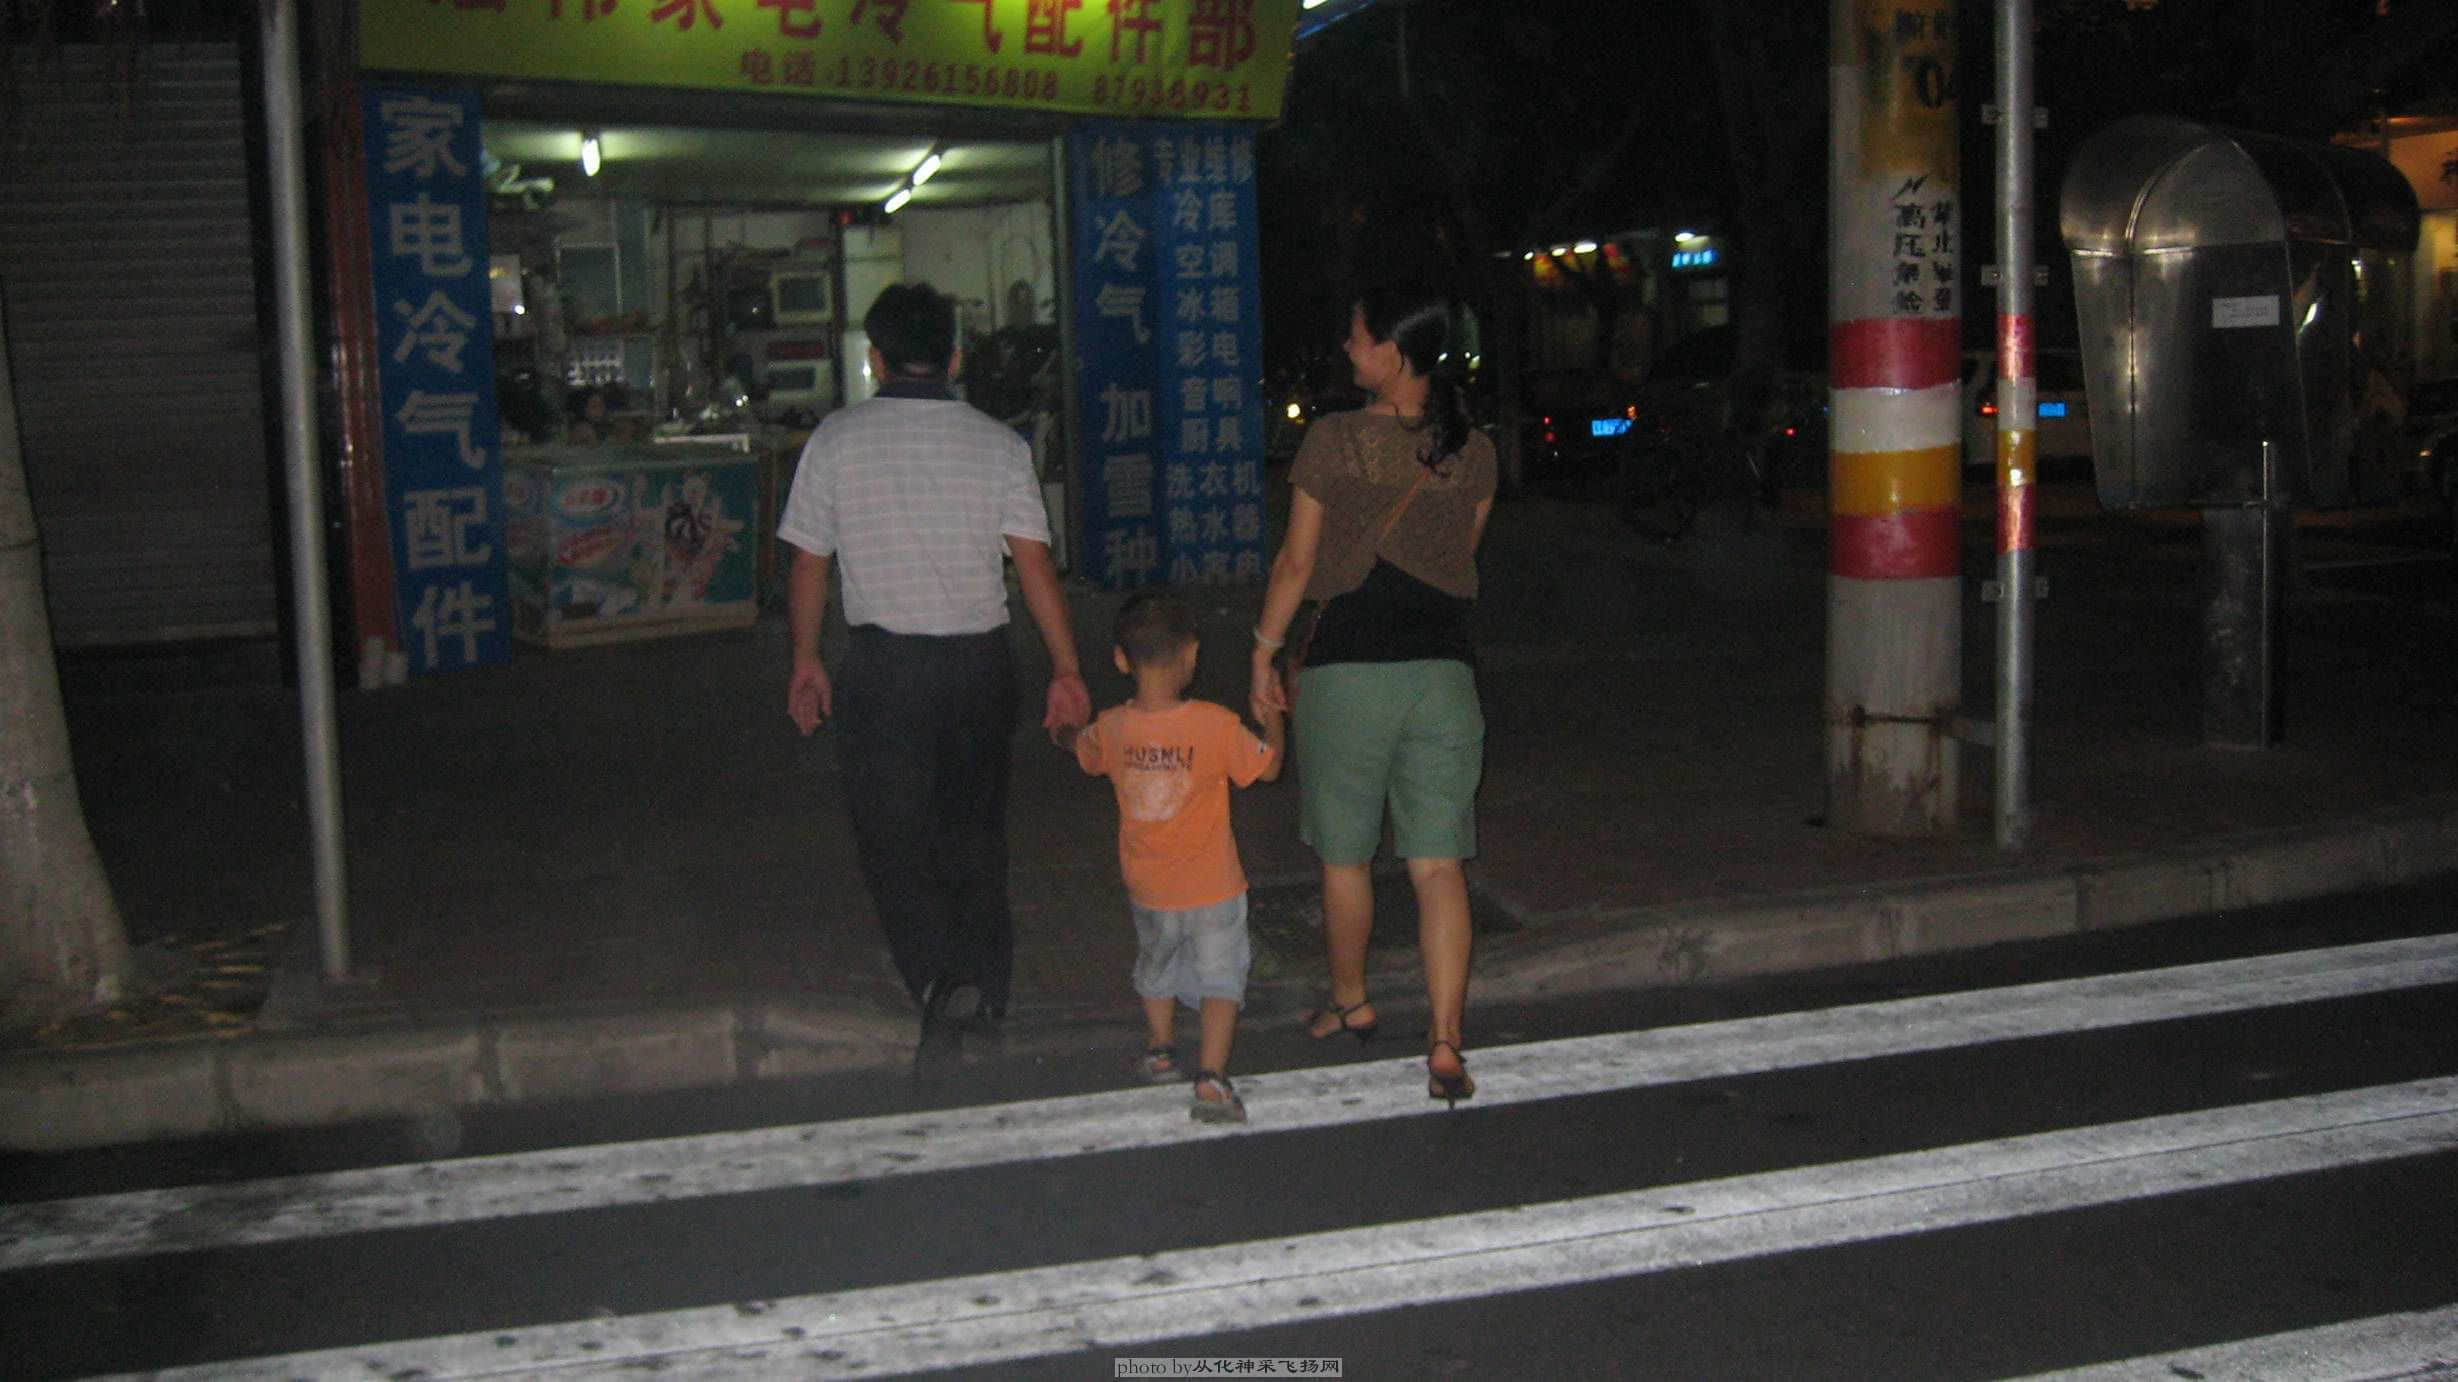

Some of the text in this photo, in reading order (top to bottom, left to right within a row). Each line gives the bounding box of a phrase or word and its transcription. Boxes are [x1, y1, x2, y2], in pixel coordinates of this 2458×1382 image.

[1175, 239, 1239, 279] 空调
[1176, 286, 1241, 321] 冰箱
[381, 98, 496, 666] 家电冷气配件
[1167, 460, 1262, 498] 洗衣机
